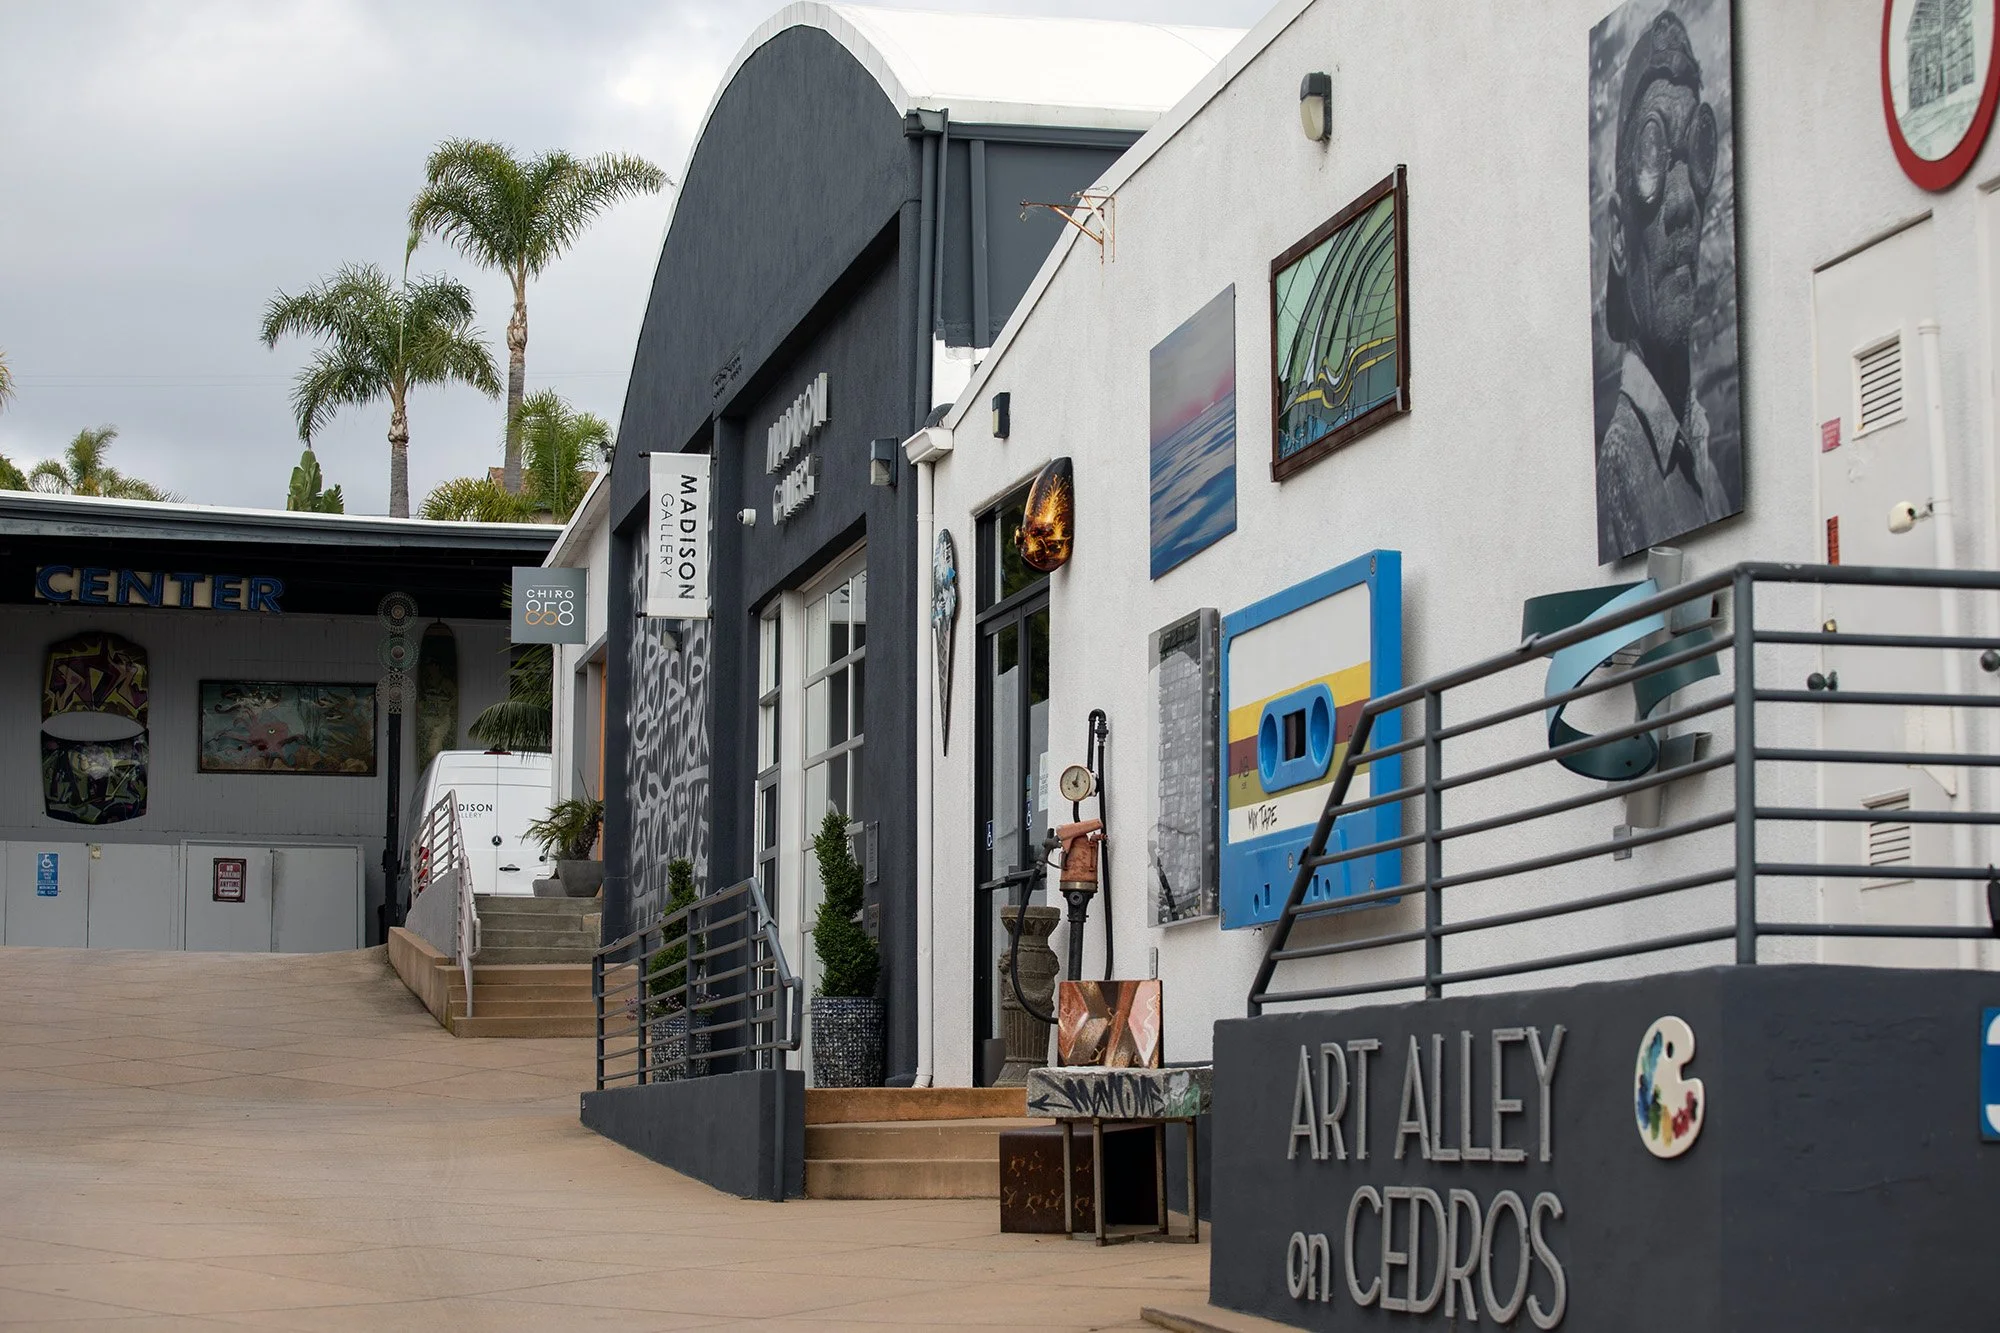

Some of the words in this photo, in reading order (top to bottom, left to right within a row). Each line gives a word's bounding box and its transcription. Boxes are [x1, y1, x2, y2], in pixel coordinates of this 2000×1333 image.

[660, 492, 675, 579] GALLERY
[678, 474, 698, 600] MADISON
[36, 564, 286, 615] CENTER
[526, 589, 574, 599] CHIRO
[440, 803, 493, 811] MDISON
[1286, 1038, 1383, 1162] ART
[1393, 1024, 1568, 1163] ALLEY
[1286, 1230, 1332, 1303] on
[1343, 1184, 1568, 1331] CEDROS
